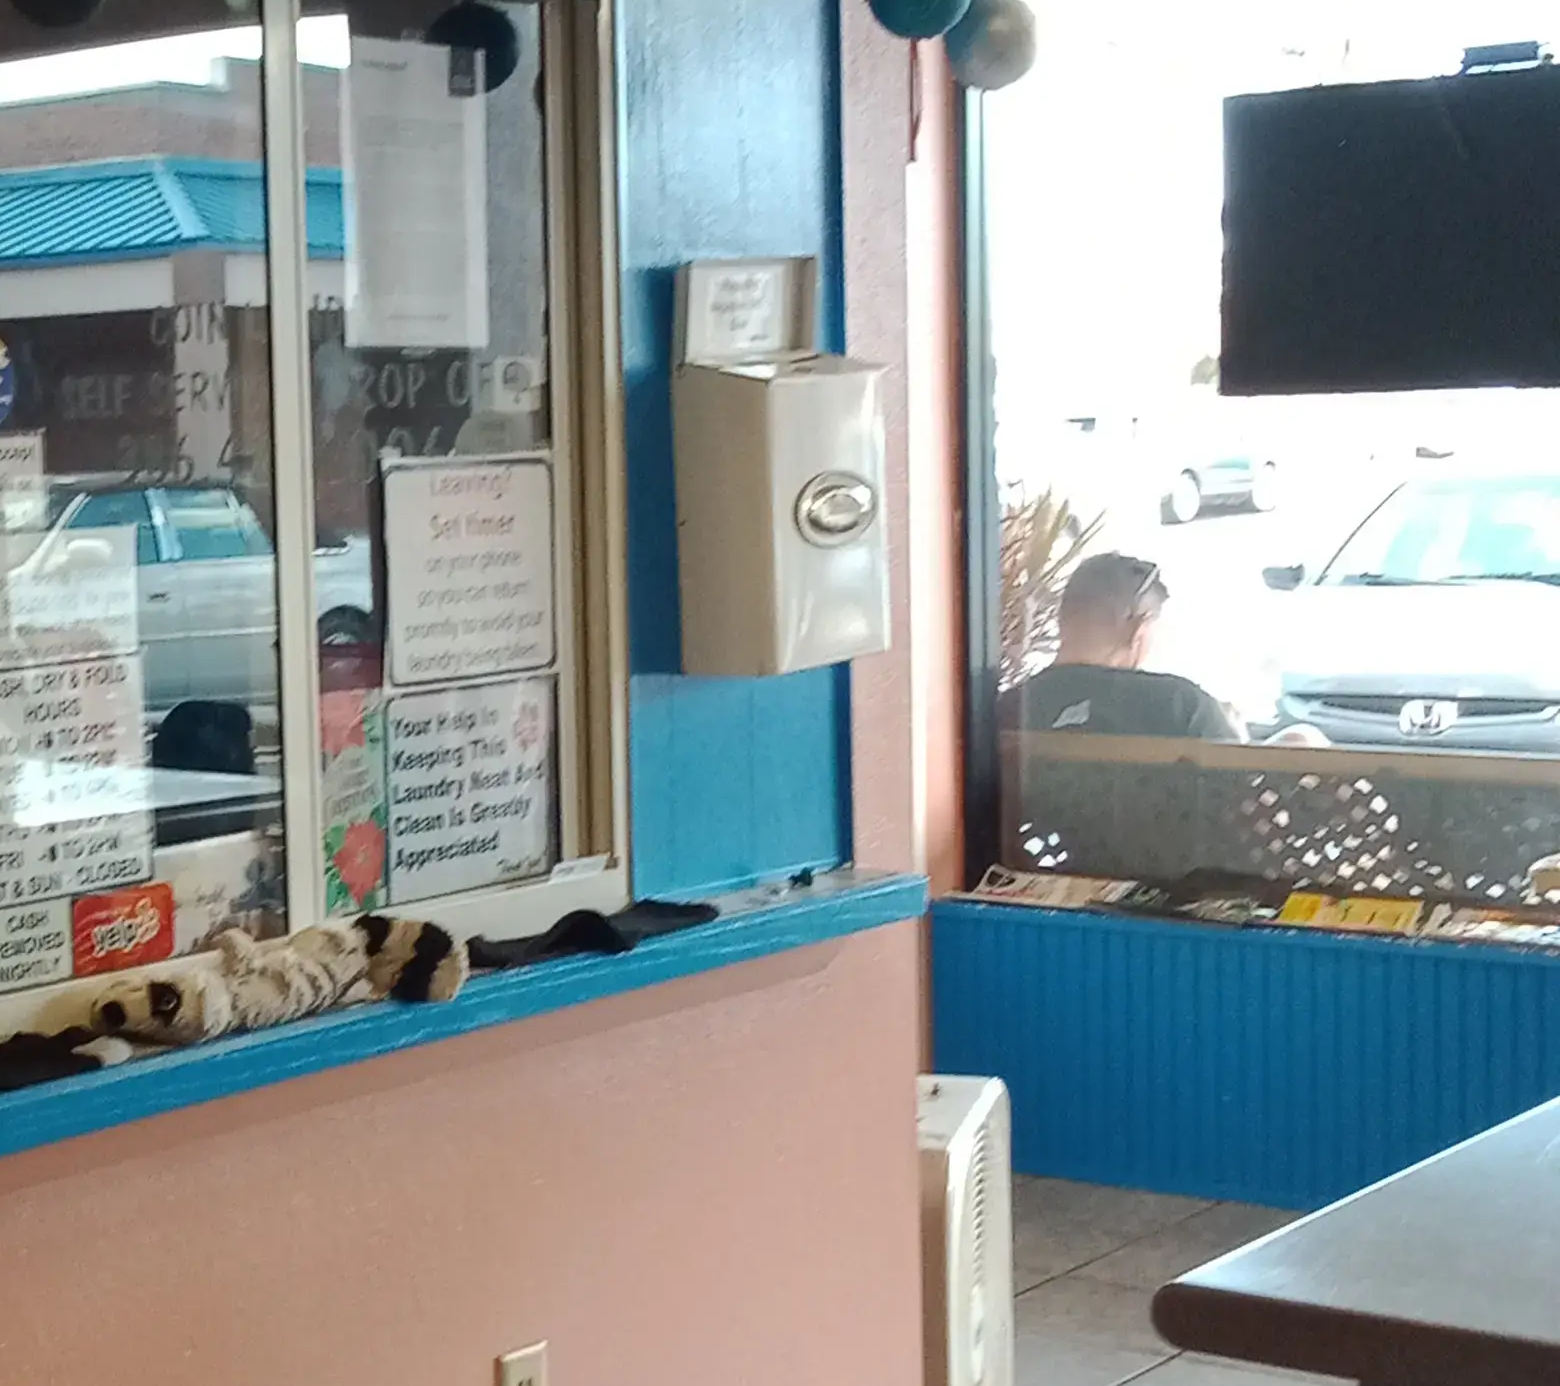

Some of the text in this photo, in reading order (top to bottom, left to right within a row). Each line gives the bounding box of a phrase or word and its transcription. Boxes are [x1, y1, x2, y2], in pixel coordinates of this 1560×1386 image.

[85, 662, 129, 686] FOLD
[23, 696, 82, 725] HOURS
[392, 715, 433, 739] Your
[436, 709, 478, 733] Help
[391, 736, 509, 774] Keeping This
[392, 775, 467, 806] Laundry
[468, 767, 512, 794] Neat
[392, 814, 446, 839] Clean
[468, 793, 533, 824] Greatly
[391, 827, 501, 874] Appreciated
[26, 870, 64, 897] SUN
[75, 856, 143, 886] CLOSED
[5, 909, 50, 934] CASH
